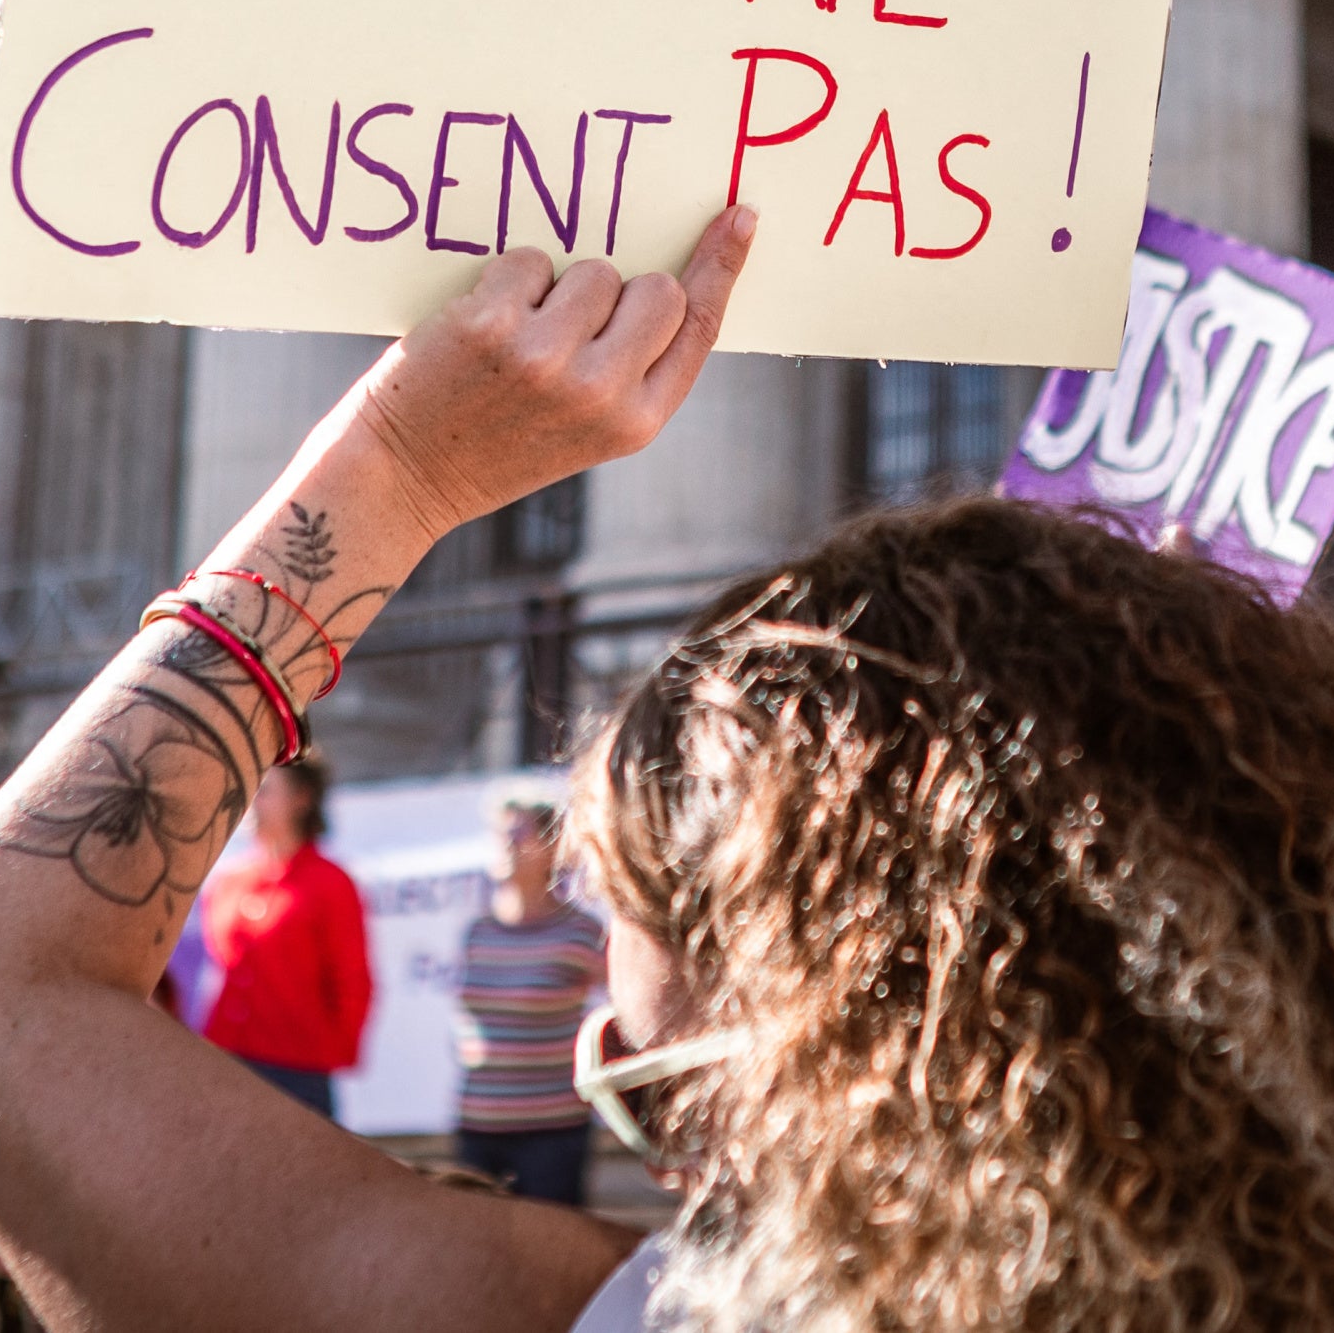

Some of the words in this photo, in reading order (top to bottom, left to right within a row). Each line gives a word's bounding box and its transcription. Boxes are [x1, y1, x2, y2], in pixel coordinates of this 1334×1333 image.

[12, 27, 672, 257] CONSENT
[727, 47, 992, 260] PAS
[1049, 52, 1090, 254] !
